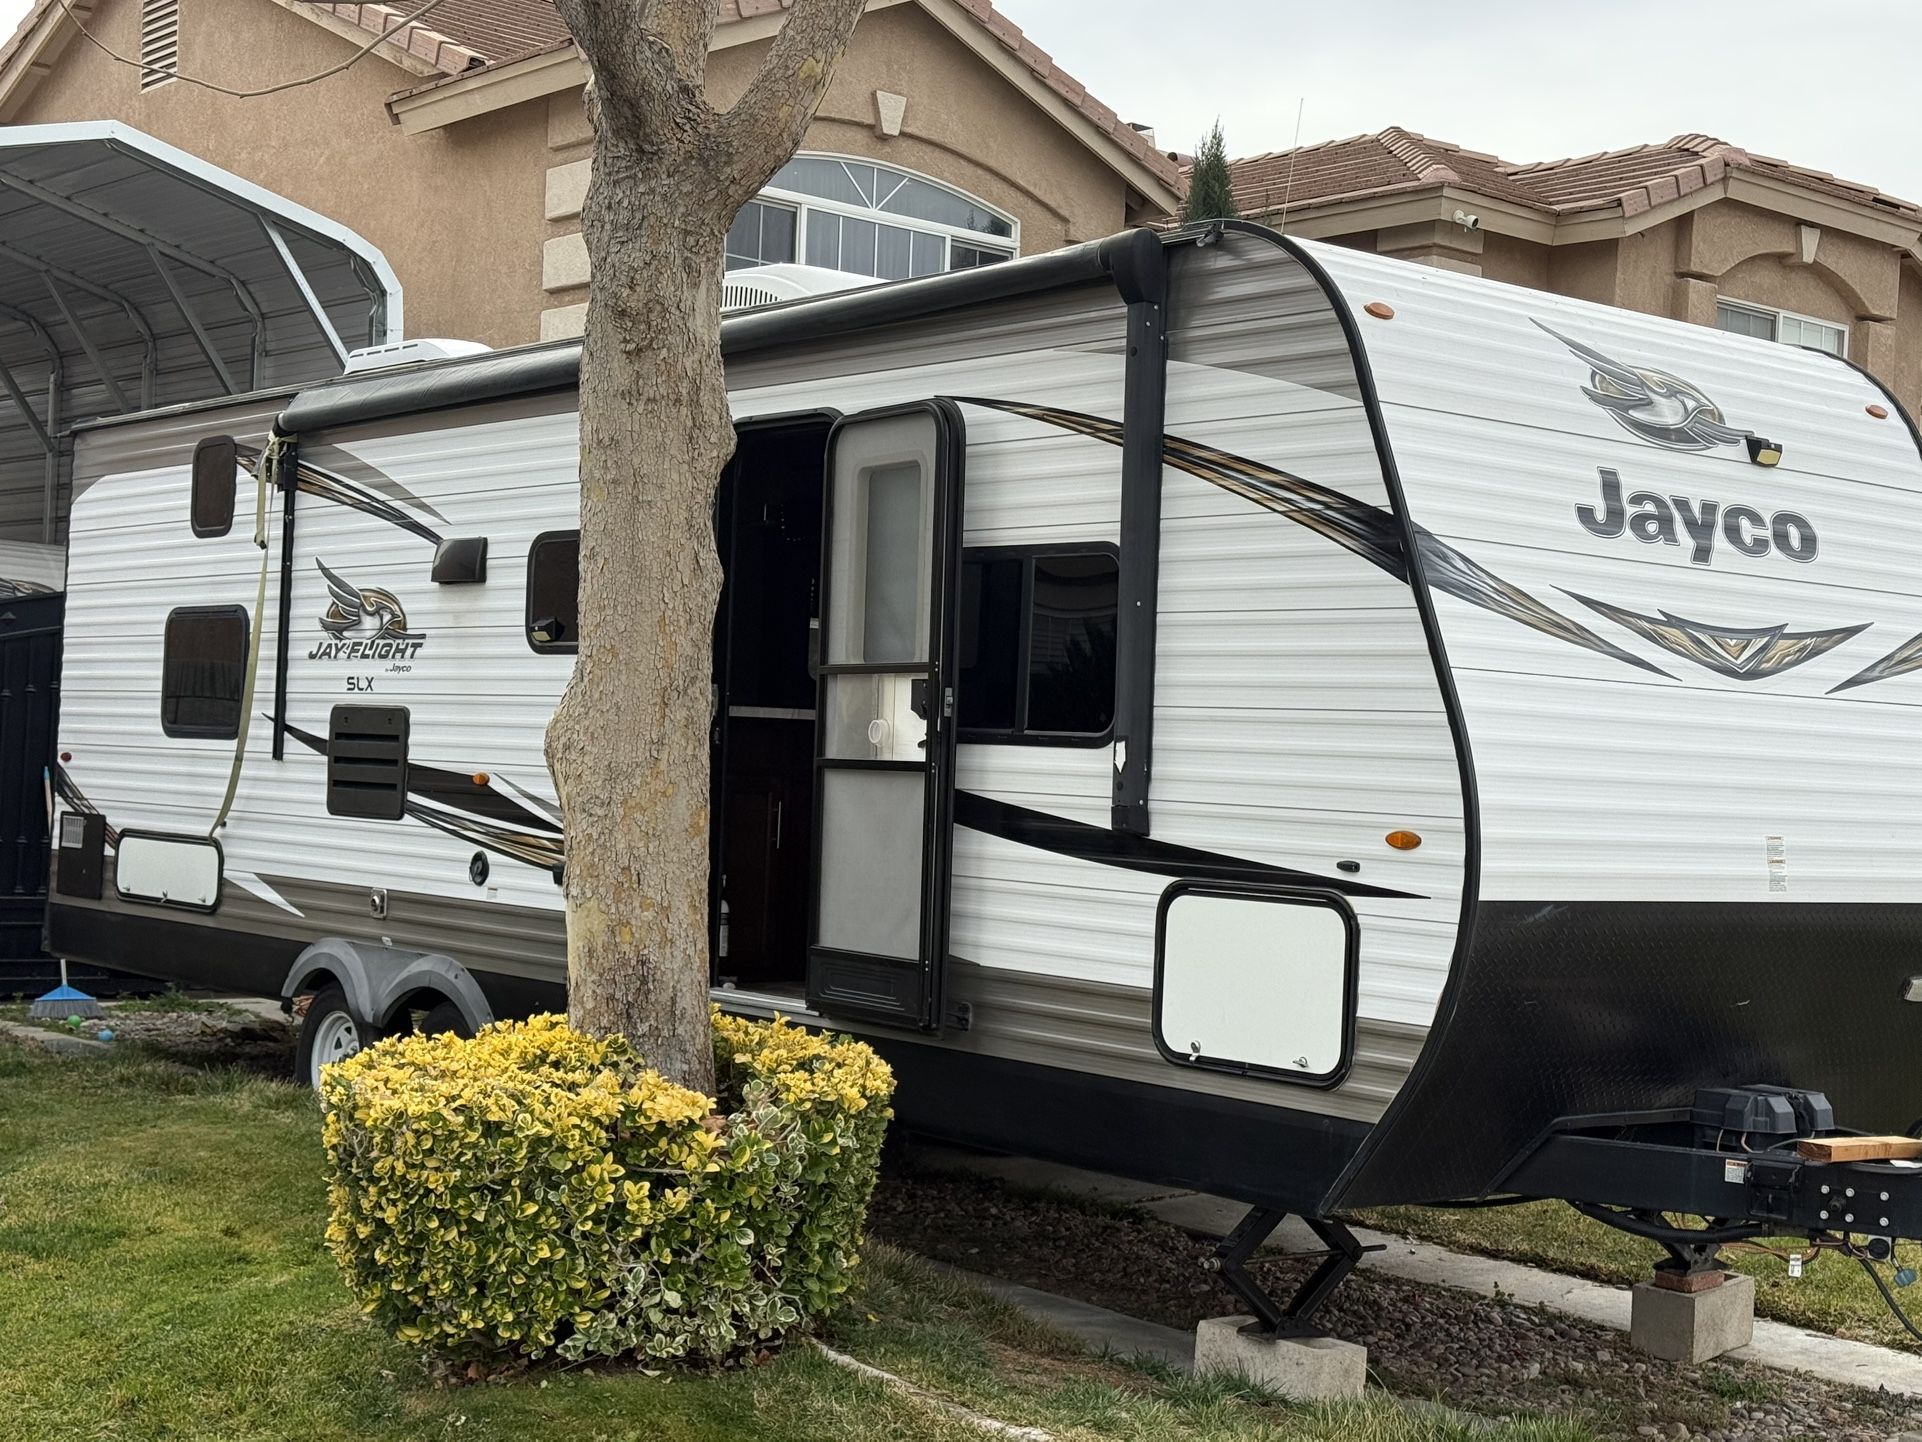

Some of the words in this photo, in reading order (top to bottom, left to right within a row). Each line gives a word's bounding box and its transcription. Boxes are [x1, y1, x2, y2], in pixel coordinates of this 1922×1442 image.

[1575, 466, 1819, 566] Jayco
[346, 640, 424, 660] FLIGHT
[390, 663, 412, 674] Jayco
[346, 676, 374, 692] SLX
